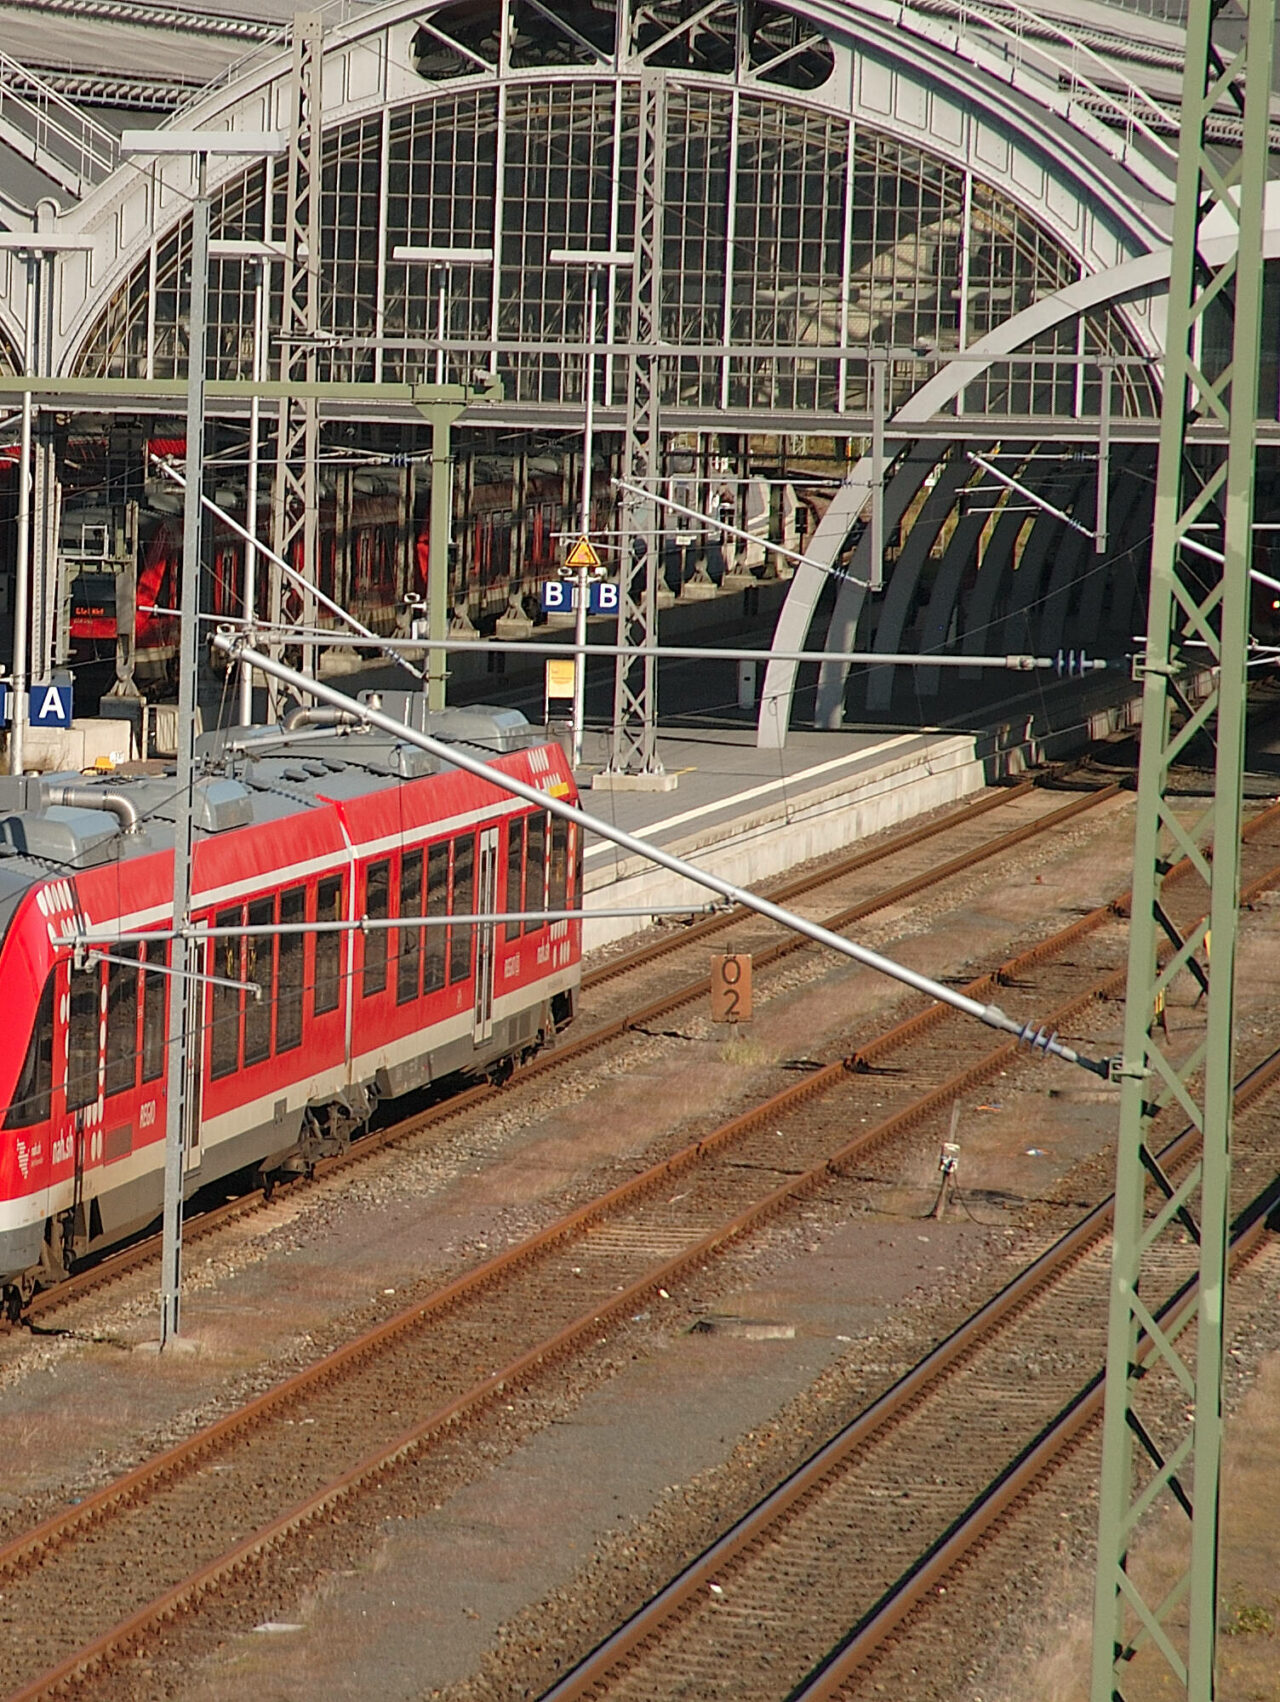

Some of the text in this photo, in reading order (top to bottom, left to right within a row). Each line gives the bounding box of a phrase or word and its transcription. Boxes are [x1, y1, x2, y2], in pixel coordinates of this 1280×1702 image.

[545, 582, 563, 606] B
[599, 583, 617, 608] B
[39, 686, 66, 719] A
[721, 959, 741, 985] 0
[723, 989, 740, 1016] 2
[139, 1099, 156, 1129] REGIO
[52, 1125, 74, 1165] nah.sh
